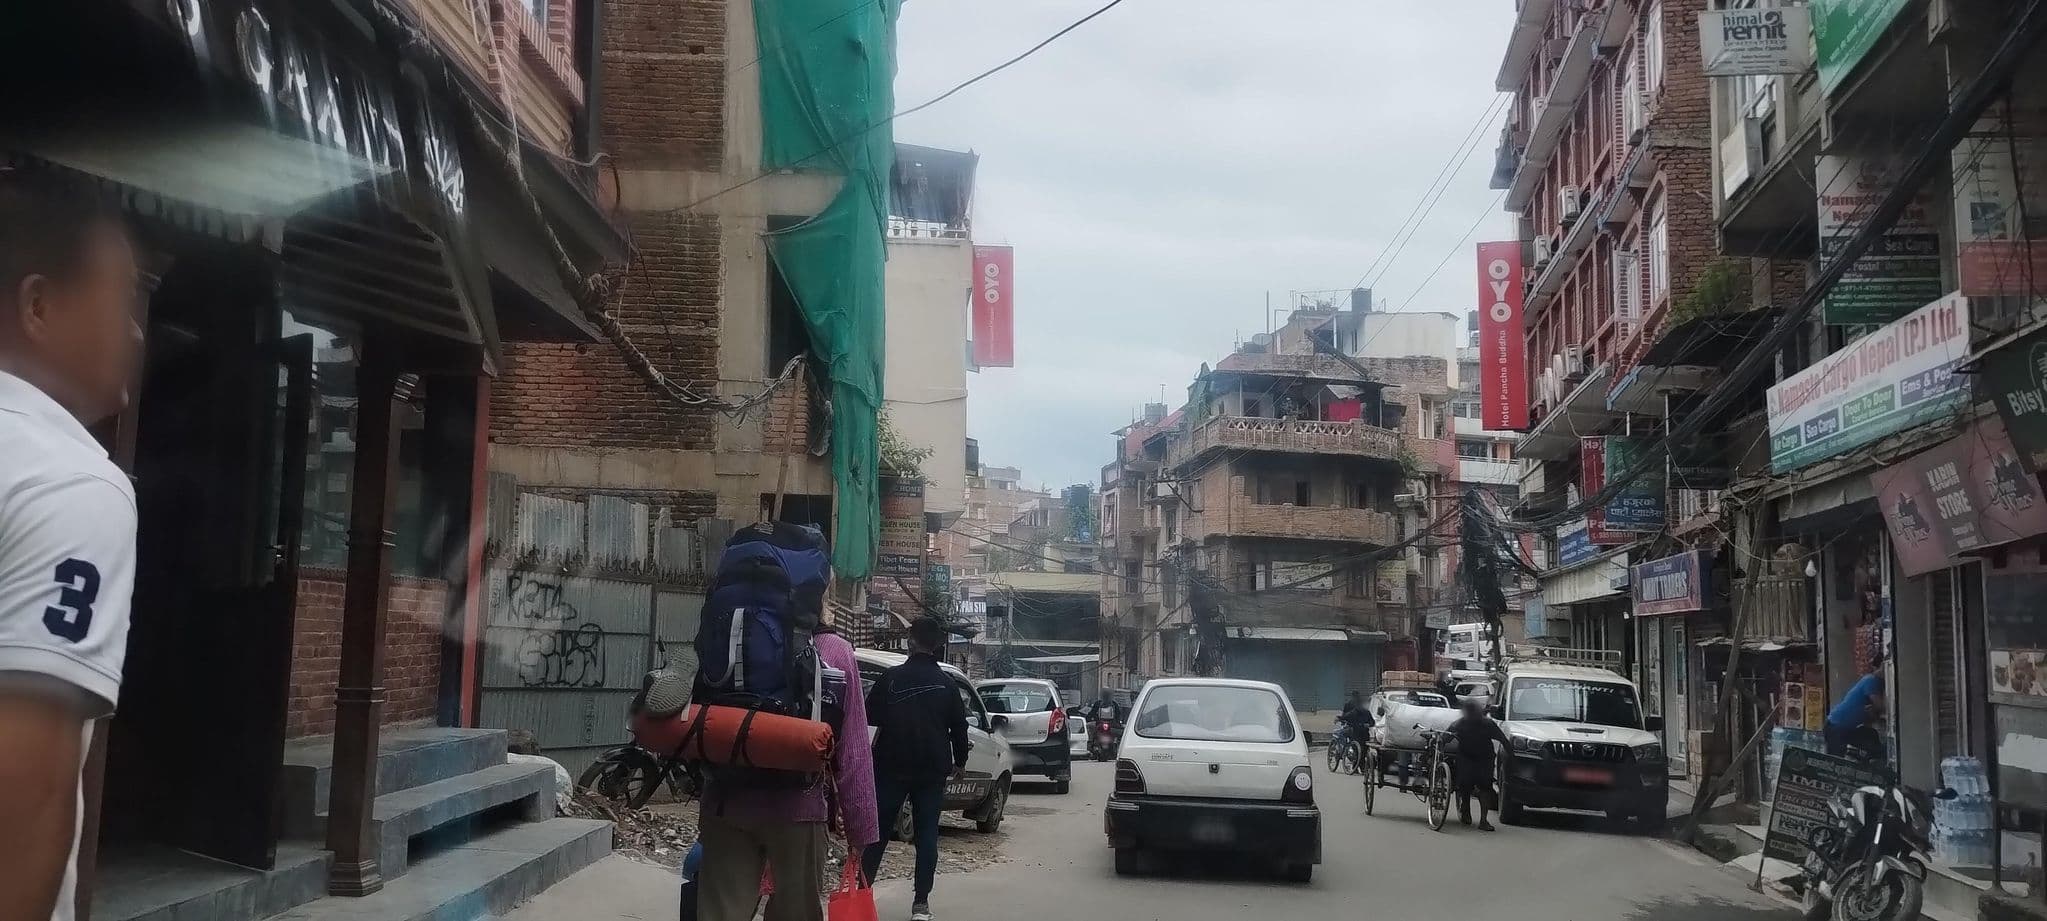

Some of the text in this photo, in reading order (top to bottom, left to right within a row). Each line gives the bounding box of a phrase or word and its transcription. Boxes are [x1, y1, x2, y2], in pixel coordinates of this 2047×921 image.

[1723, 12, 1761, 25] himal
[1723, 22, 1787, 41] remit
[985, 263, 1000, 304] OYO
[1489, 259, 1512, 323] OYO
[1822, 355, 1858, 395] Cargo
[1859, 327, 1901, 382] Nepal
[1930, 299, 1962, 347] Ltd.
[1501, 403, 1509, 427] Hotel
[2007, 388, 2047, 416] Bitsy
[1936, 489, 1972, 520] STORE
[42, 558, 101, 643] 3
